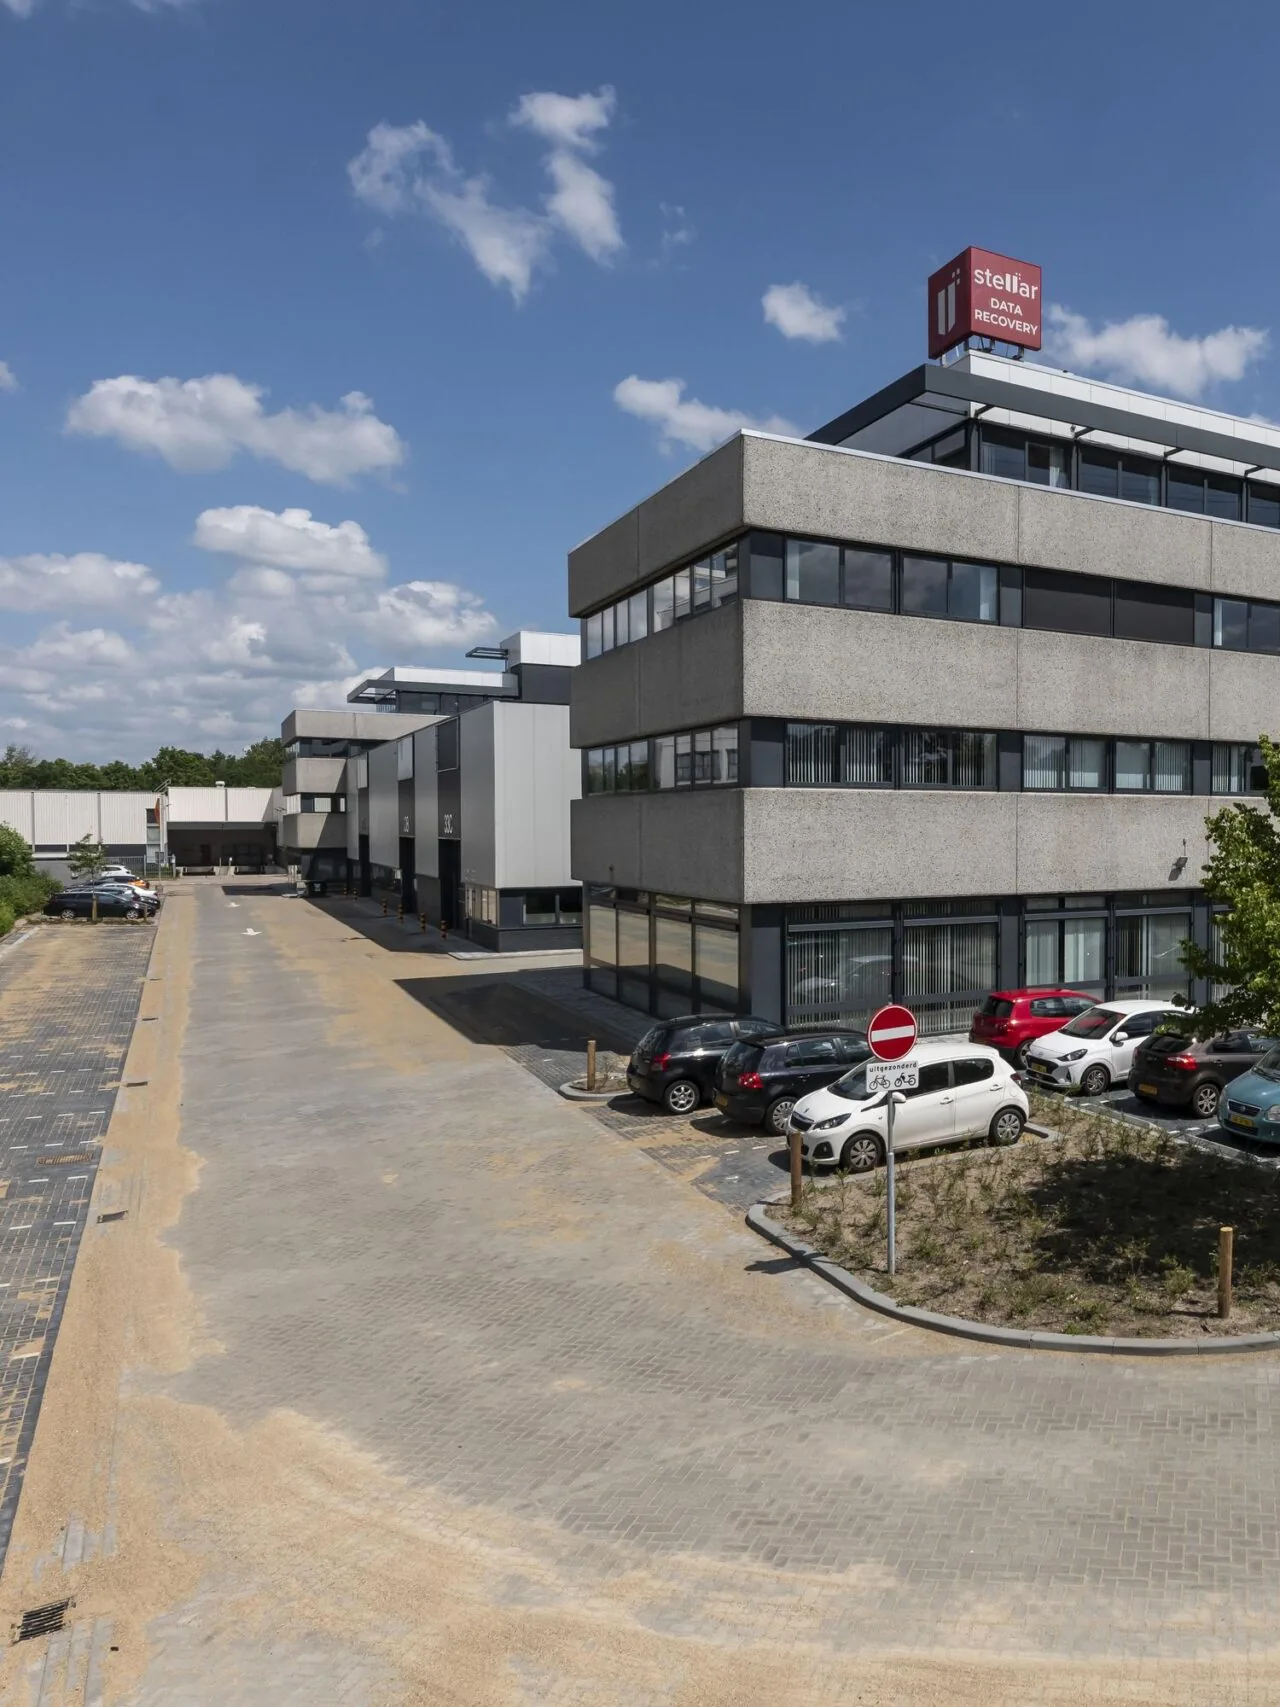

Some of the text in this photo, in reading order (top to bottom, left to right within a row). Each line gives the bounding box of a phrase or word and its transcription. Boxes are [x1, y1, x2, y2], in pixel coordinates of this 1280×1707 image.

[974, 268, 1038, 299] stellar
[990, 298, 1023, 316] DATA
[974, 309, 1038, 335] RECOVERY
[869, 1062, 917, 1073] uitgezonderd
